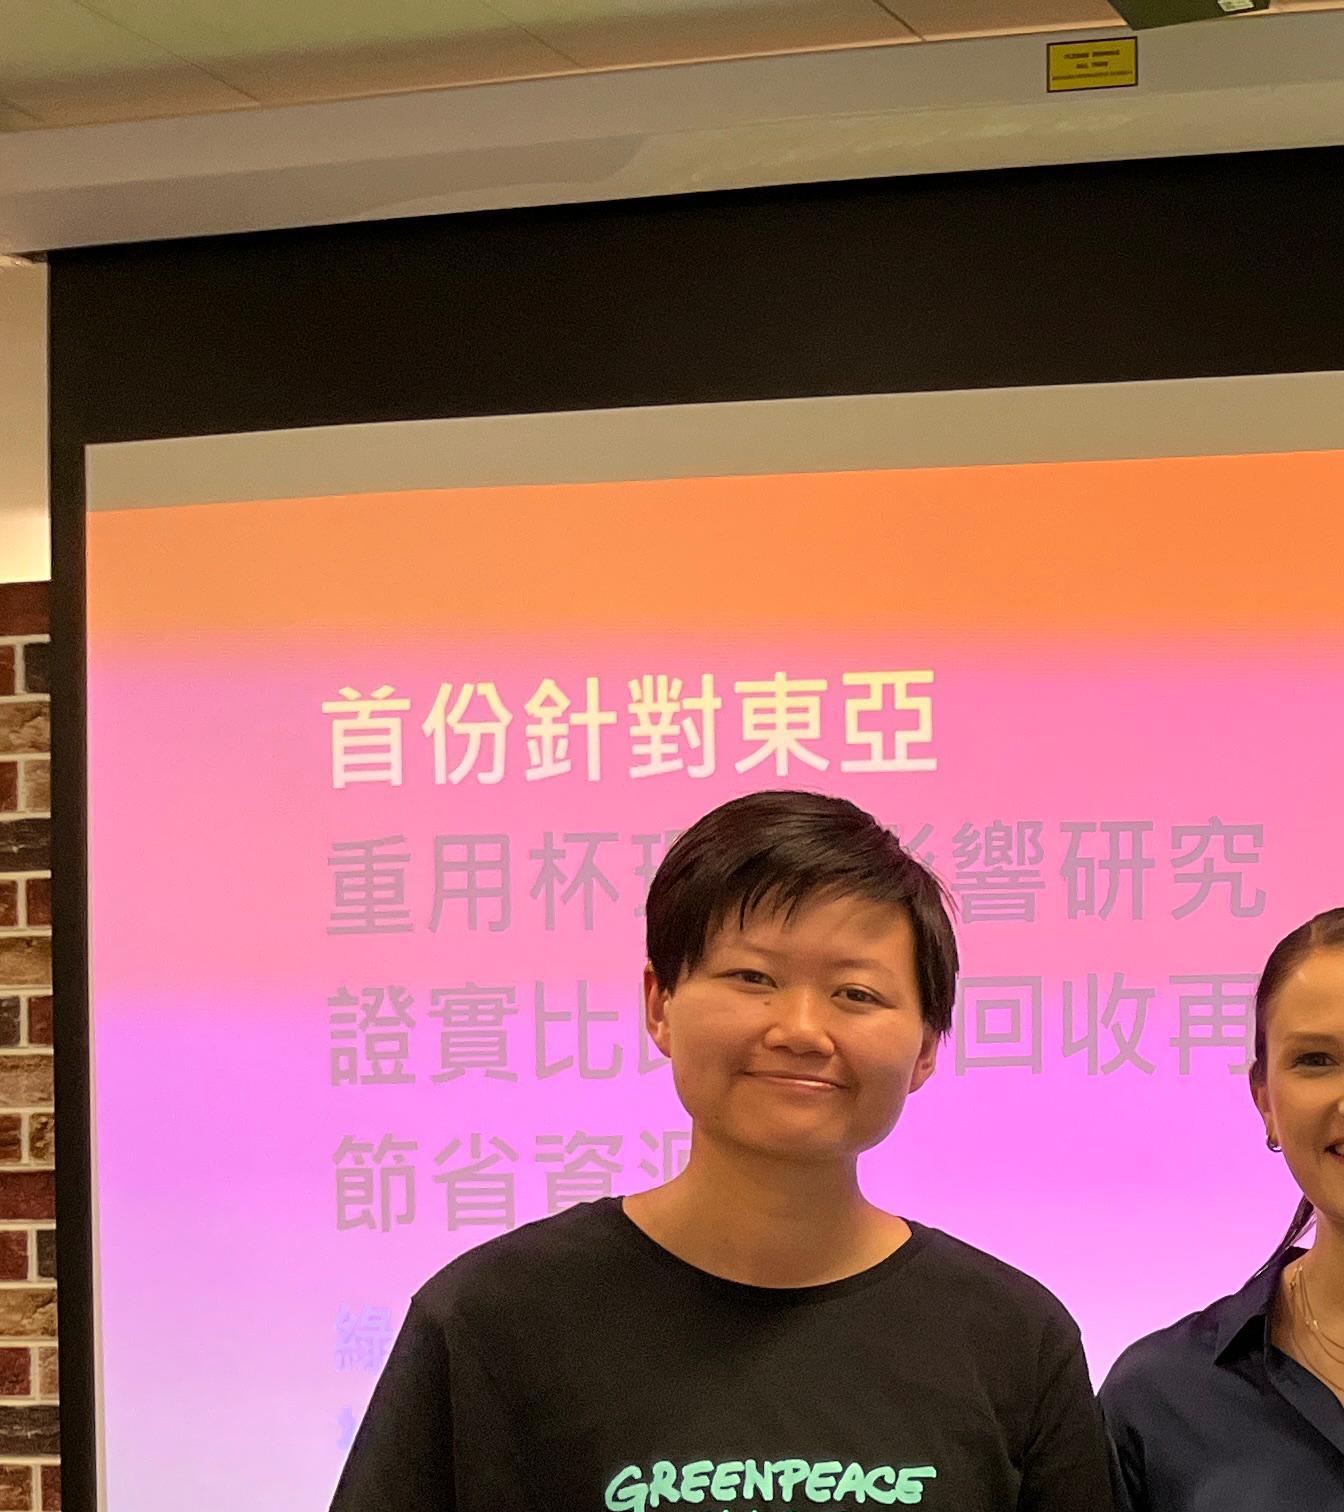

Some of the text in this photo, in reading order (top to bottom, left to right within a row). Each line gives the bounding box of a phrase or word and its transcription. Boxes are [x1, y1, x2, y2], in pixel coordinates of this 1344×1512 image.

[320, 669, 937, 789] 首份針對東亞
